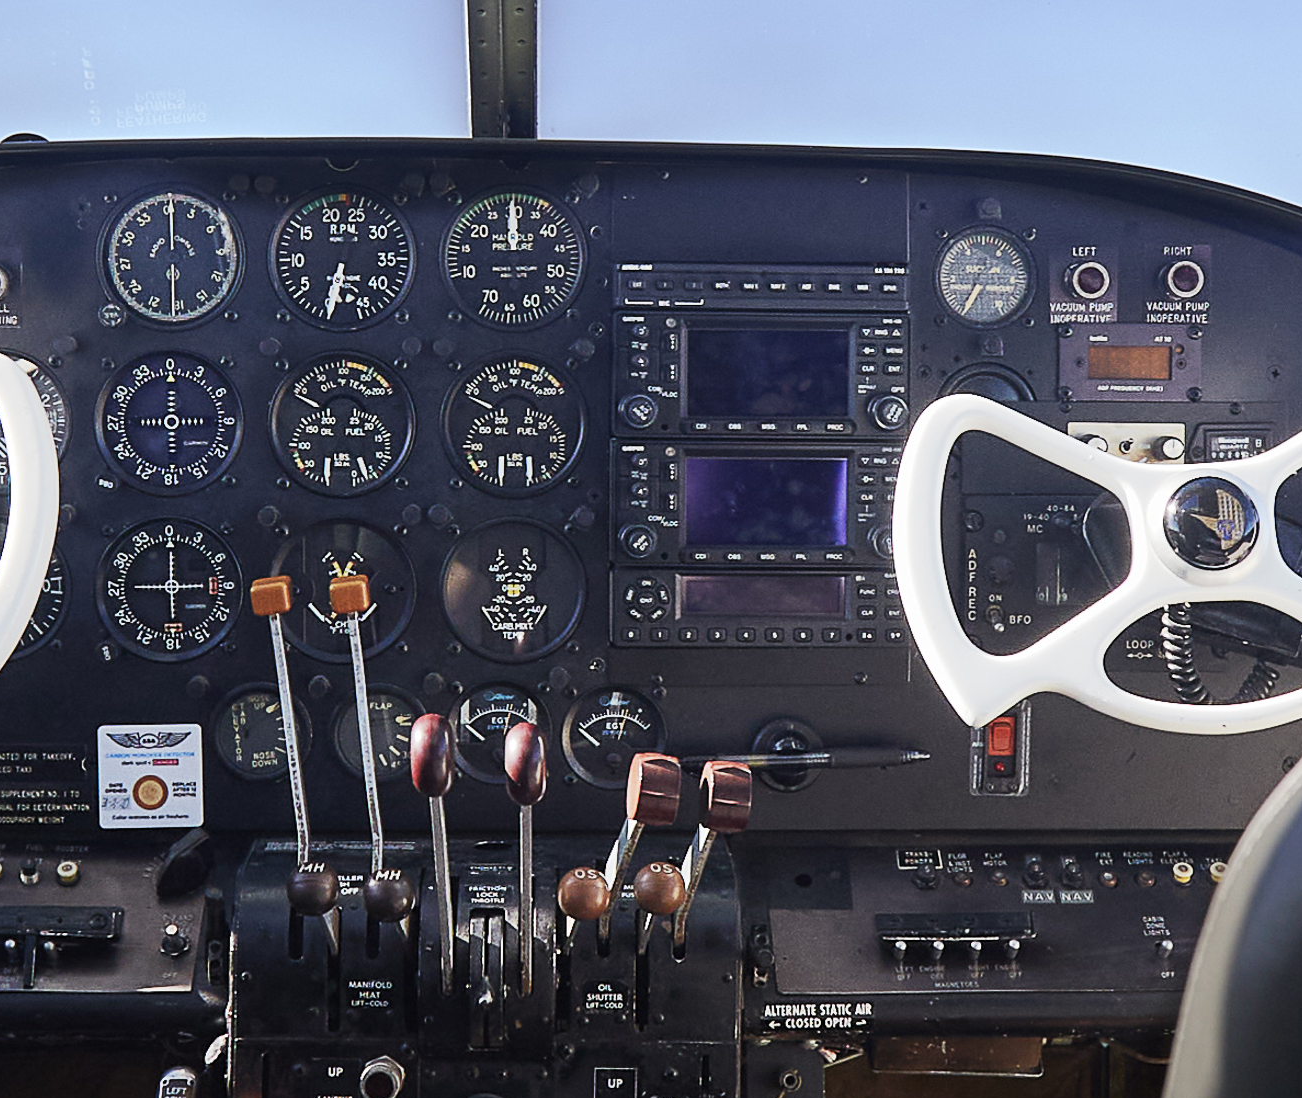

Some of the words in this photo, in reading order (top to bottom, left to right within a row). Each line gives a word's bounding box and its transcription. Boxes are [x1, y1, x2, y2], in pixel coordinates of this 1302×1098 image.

[322, 209, 340, 222] 20
[348, 208, 365, 222] 25
[301, 226, 312, 240] 15
[369, 225, 387, 239] 30
[471, 224, 488, 237] 20
[539, 224, 557, 237] 40
[1073, 247, 1096, 256] LEFT
[1164, 247, 1192, 255] RIGHT
[292, 253, 304, 267] 10
[378, 252, 396, 266] 35
[463, 265, 476, 278] 10
[547, 264, 565, 278] 50
[301, 277, 310, 291] 5
[368, 276, 387, 290] 40
[482, 289, 498, 303] 70
[523, 294, 540, 307] 60
[356, 297, 370, 308] 45
[1050, 303, 1085, 311] VACUUM
[1089, 303, 1114, 311] PUMP
[1147, 302, 1182, 311] VACUUM
[1185, 302, 1209, 311] PUMP
[1050, 315, 1112, 323] INOPERATIVE
[1147, 314, 1208, 323] INOPERATIVE
[166, 358, 175, 370] 0
[132, 365, 150, 380] 33
[194, 366, 204, 377] 3
[321, 381, 337, 392] OIL
[113, 386, 128, 402] 30
[215, 388, 227, 398] 6
[107, 415, 119, 430] 27
[494, 427, 509, 435] OIL
[165, 525, 173, 536] 0
[1027, 525, 1043, 533] MC
[132, 531, 149, 546] 33
[194, 532, 203, 543] 3
[113, 552, 128, 569] 30
[214, 553, 226, 563] 6
[108, 581, 120, 597] 27
[1009, 615, 1031, 624] BFO
[1125, 640, 1154, 650] LOOP
[492, 717, 509, 725] EGT
[299, 863, 325, 873] MH
[375, 870, 401, 881] MH
[1024, 892, 1054, 900] NAV
[1062, 892, 1092, 900] NAV
[349, 981, 392, 989] MANIFOLD
[765, 1004, 816, 1017] ALTERNATE
[820, 1004, 852, 1015] STATIC
[855, 1003, 872, 1015] AIR
[785, 1018, 821, 1028] CLOSED
[825, 1017, 852, 1028] OPEN
[328, 1067, 343, 1077] UP
[608, 1079, 623, 1088] UP
